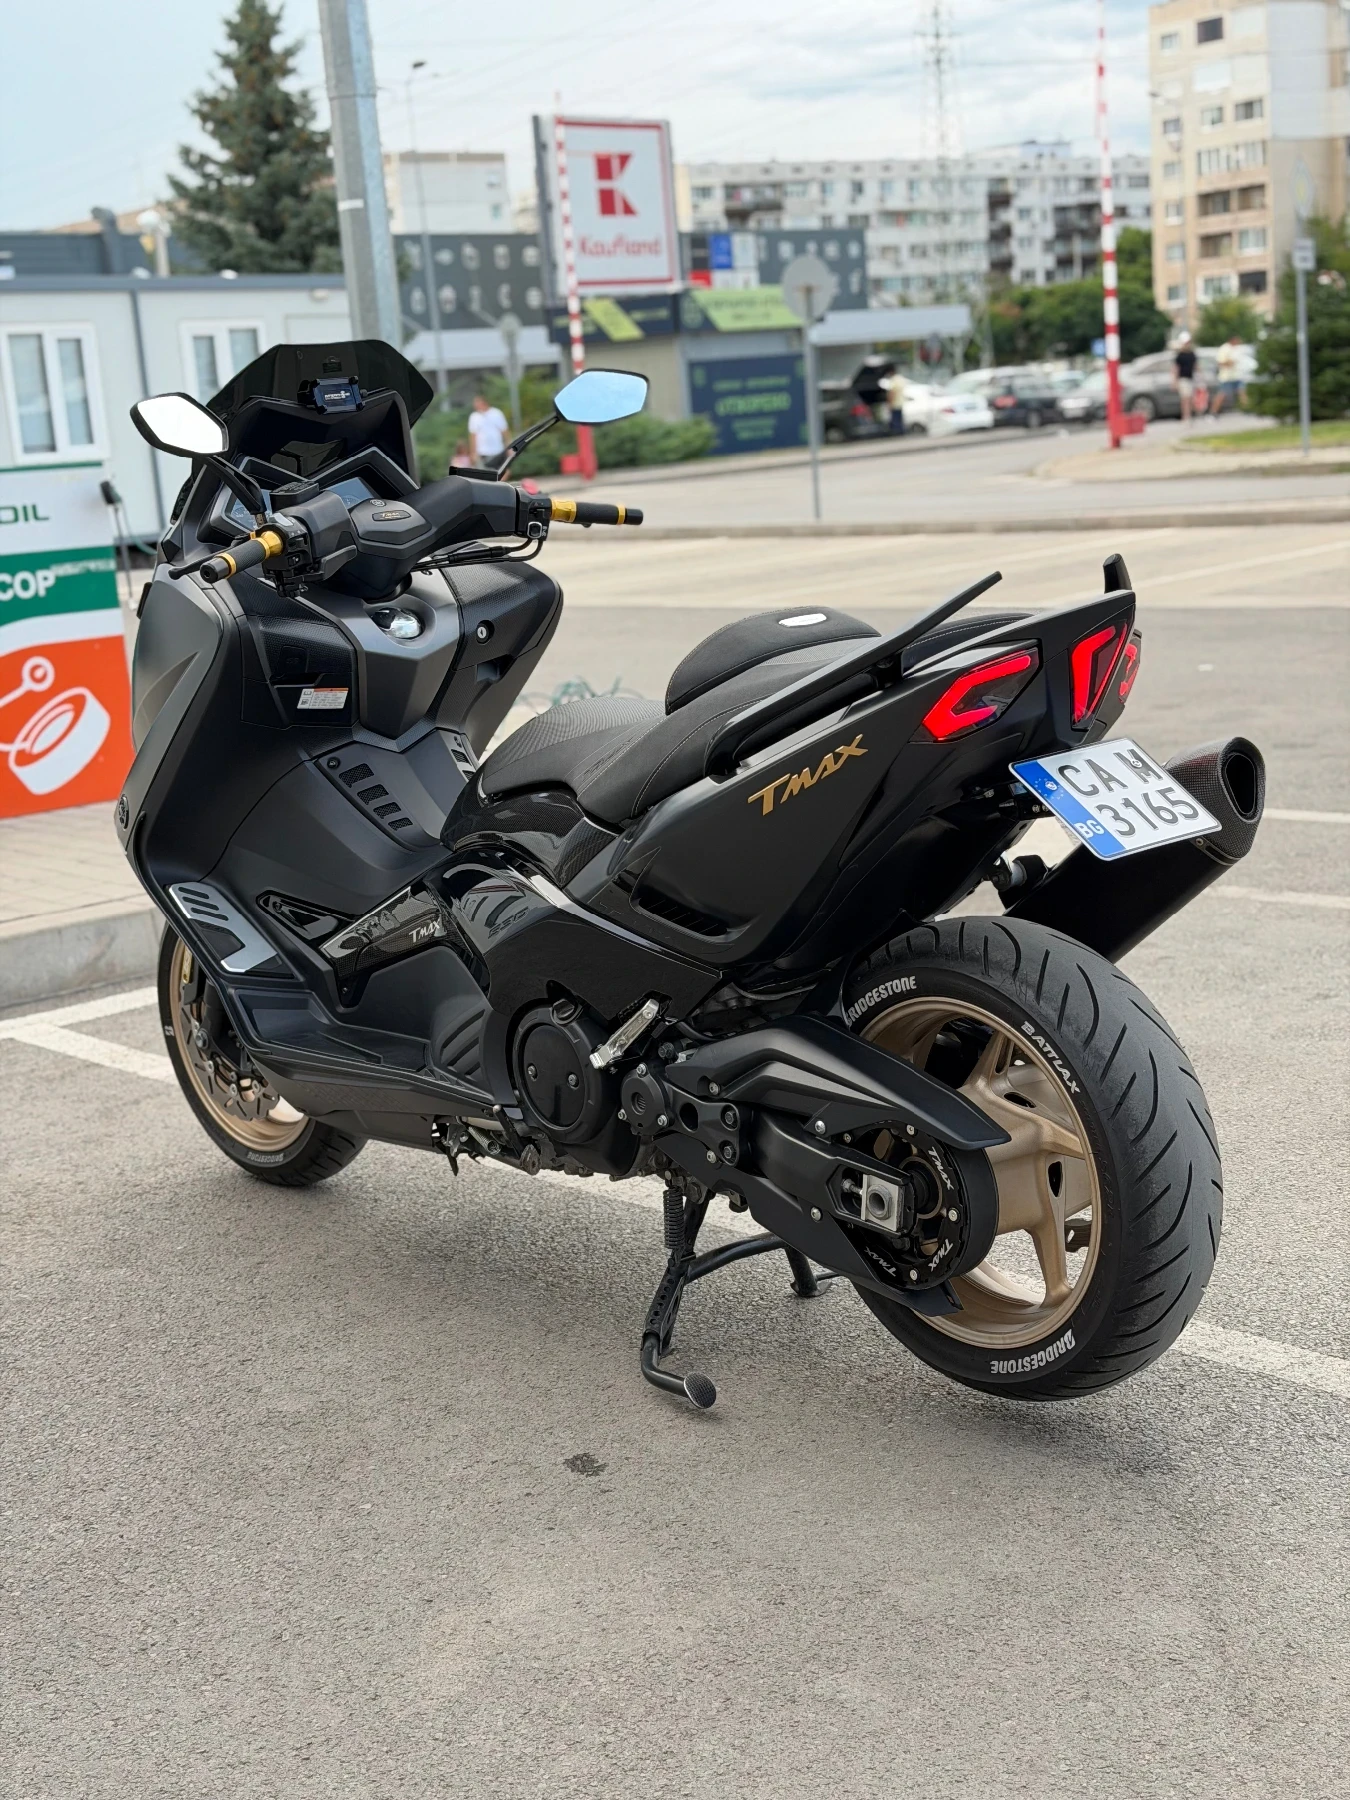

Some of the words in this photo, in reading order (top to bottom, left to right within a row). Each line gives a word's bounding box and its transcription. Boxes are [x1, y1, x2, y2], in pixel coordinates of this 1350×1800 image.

[1057, 758, 1129, 797] CA
[1074, 819, 1105, 839] BG
[1094, 786, 1200, 839] 3165
[1021, 1020, 1080, 1094] BATTLAX
[990, 1328, 1076, 1374] BRIDGESTONE
